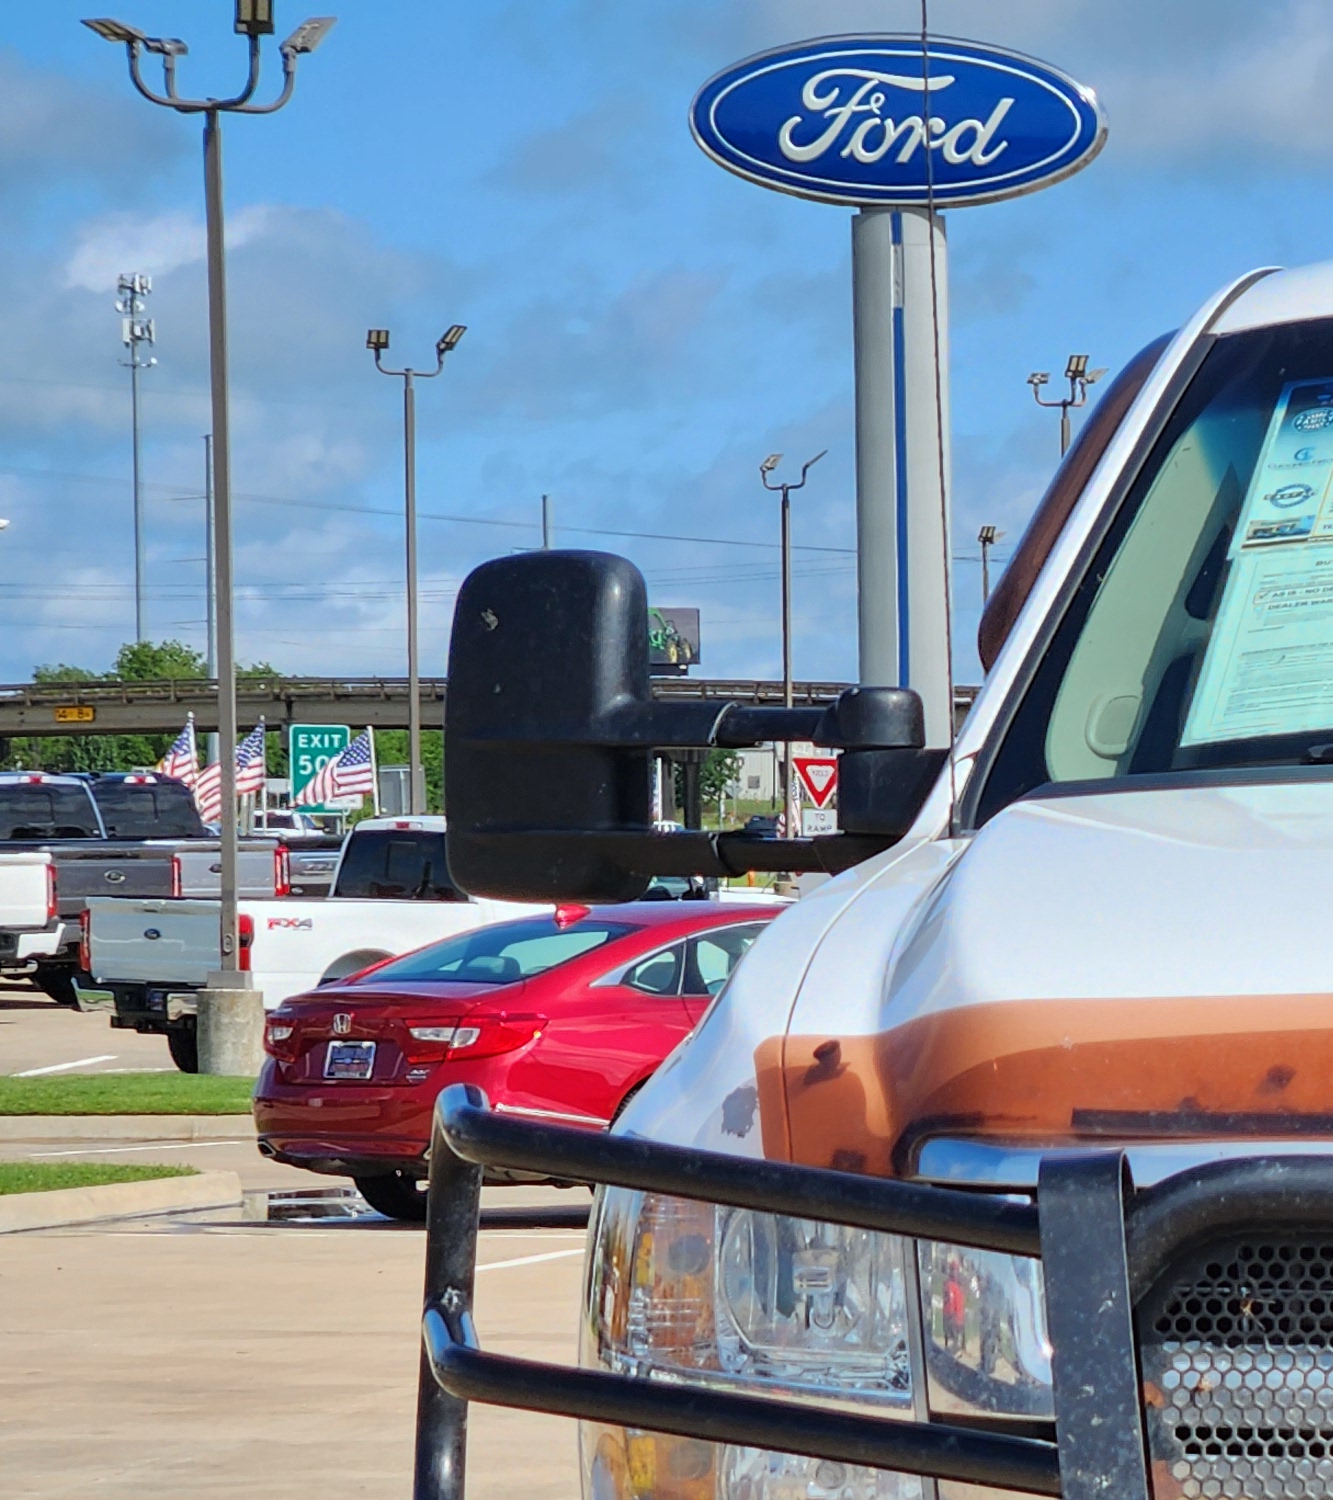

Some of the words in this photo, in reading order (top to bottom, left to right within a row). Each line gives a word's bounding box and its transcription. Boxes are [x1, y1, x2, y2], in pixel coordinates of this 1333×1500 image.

[779, 67, 1016, 167] Ford
[1267, 601, 1309, 611] DEALER
[298, 734, 342, 748] EXIT
[298, 755, 332, 775] 50
[814, 813, 826, 821] TO
[807, 824, 832, 832] RAMP
[267, 917, 312, 931] FX4
